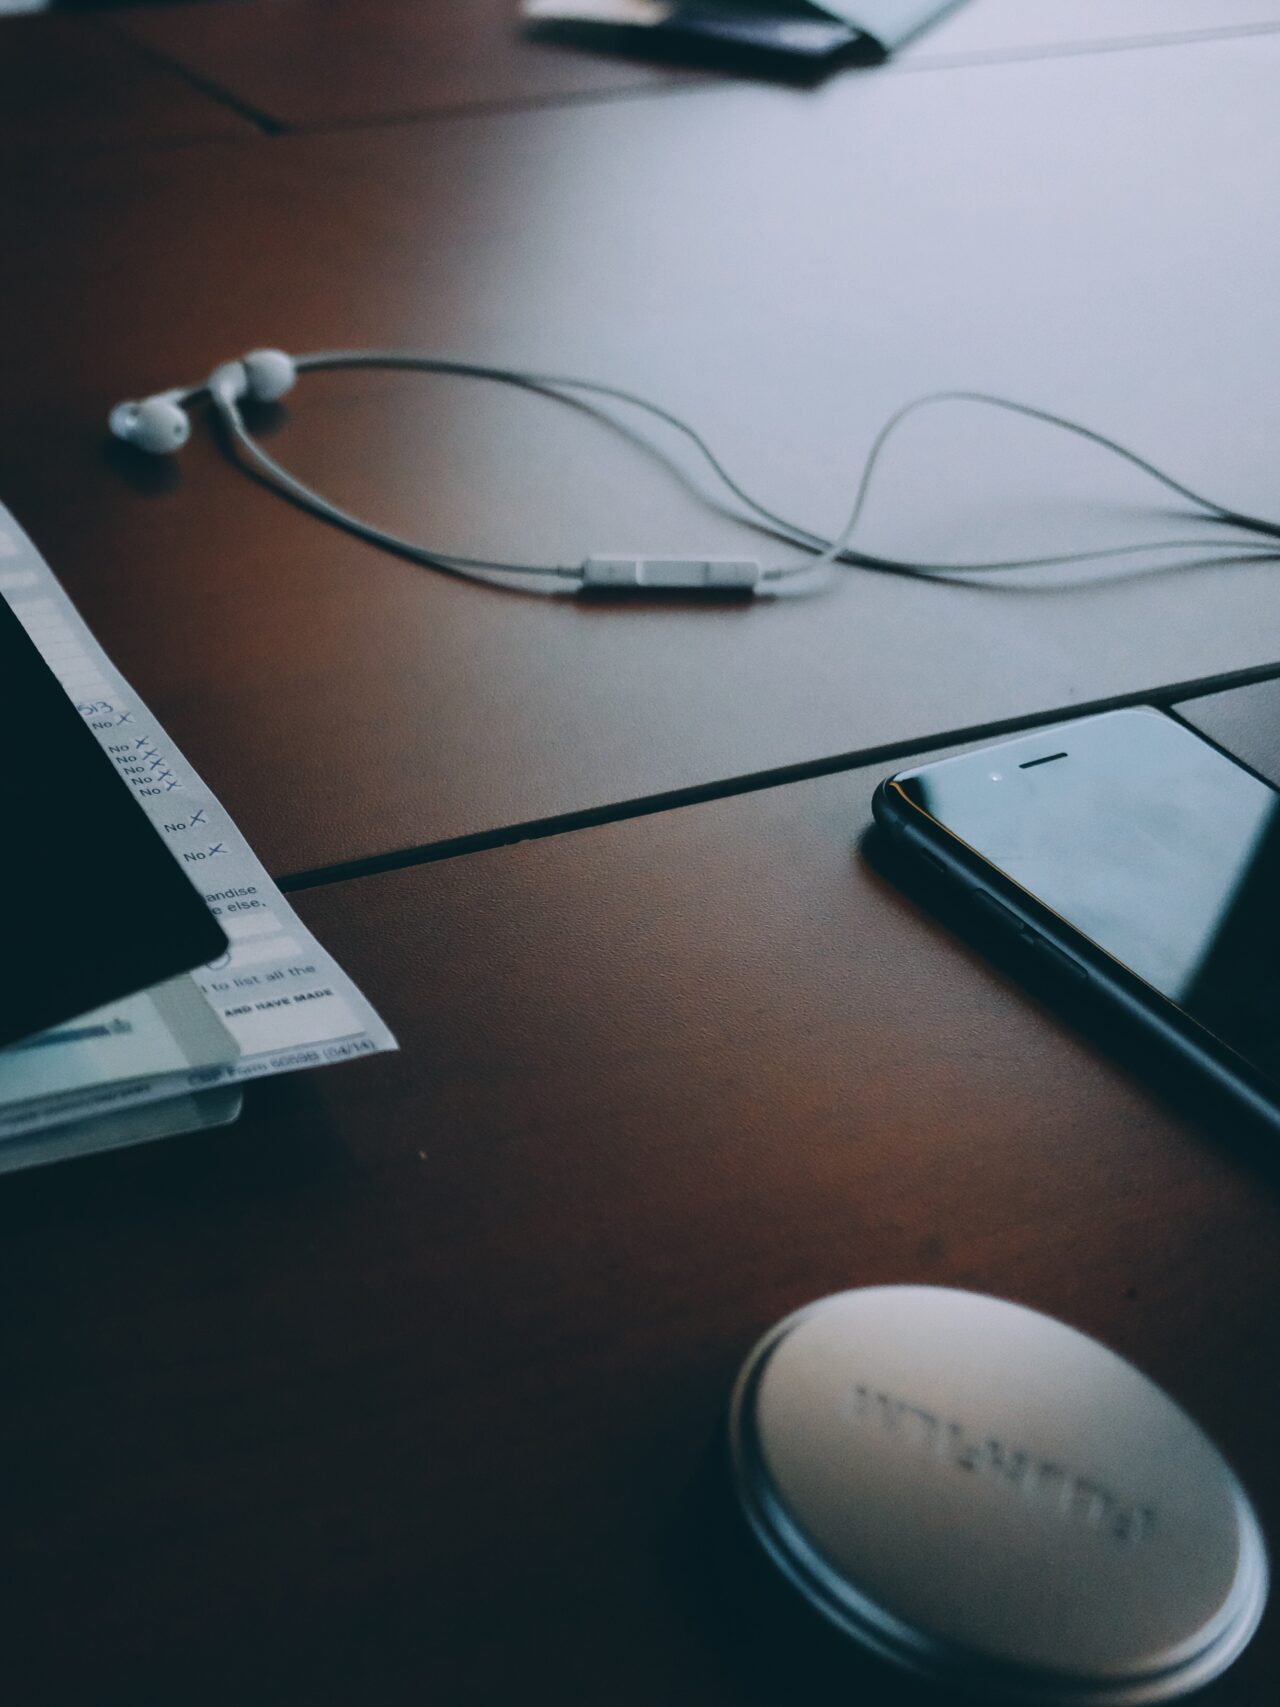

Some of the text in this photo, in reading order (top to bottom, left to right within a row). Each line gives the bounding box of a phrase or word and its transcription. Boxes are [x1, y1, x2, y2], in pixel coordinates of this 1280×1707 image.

[92, 721, 113, 729] No
[108, 744, 129, 753] No
[116, 755, 137, 763] No
[124, 766, 145, 774] No
[131, 777, 153, 785] No
[139, 788, 161, 796] No
[163, 823, 186, 832] No
[183, 852, 206, 861] No
[205, 886, 257, 902] andise
[227, 900, 267, 912] else,
[213, 982, 230, 992] to
[234, 976, 259, 988] list
[266, 970, 285, 983] all
[289, 964, 316, 979] the
[224, 988, 335, 1018] AND HAVE MADE
[222, 1061, 267, 1079] Form
